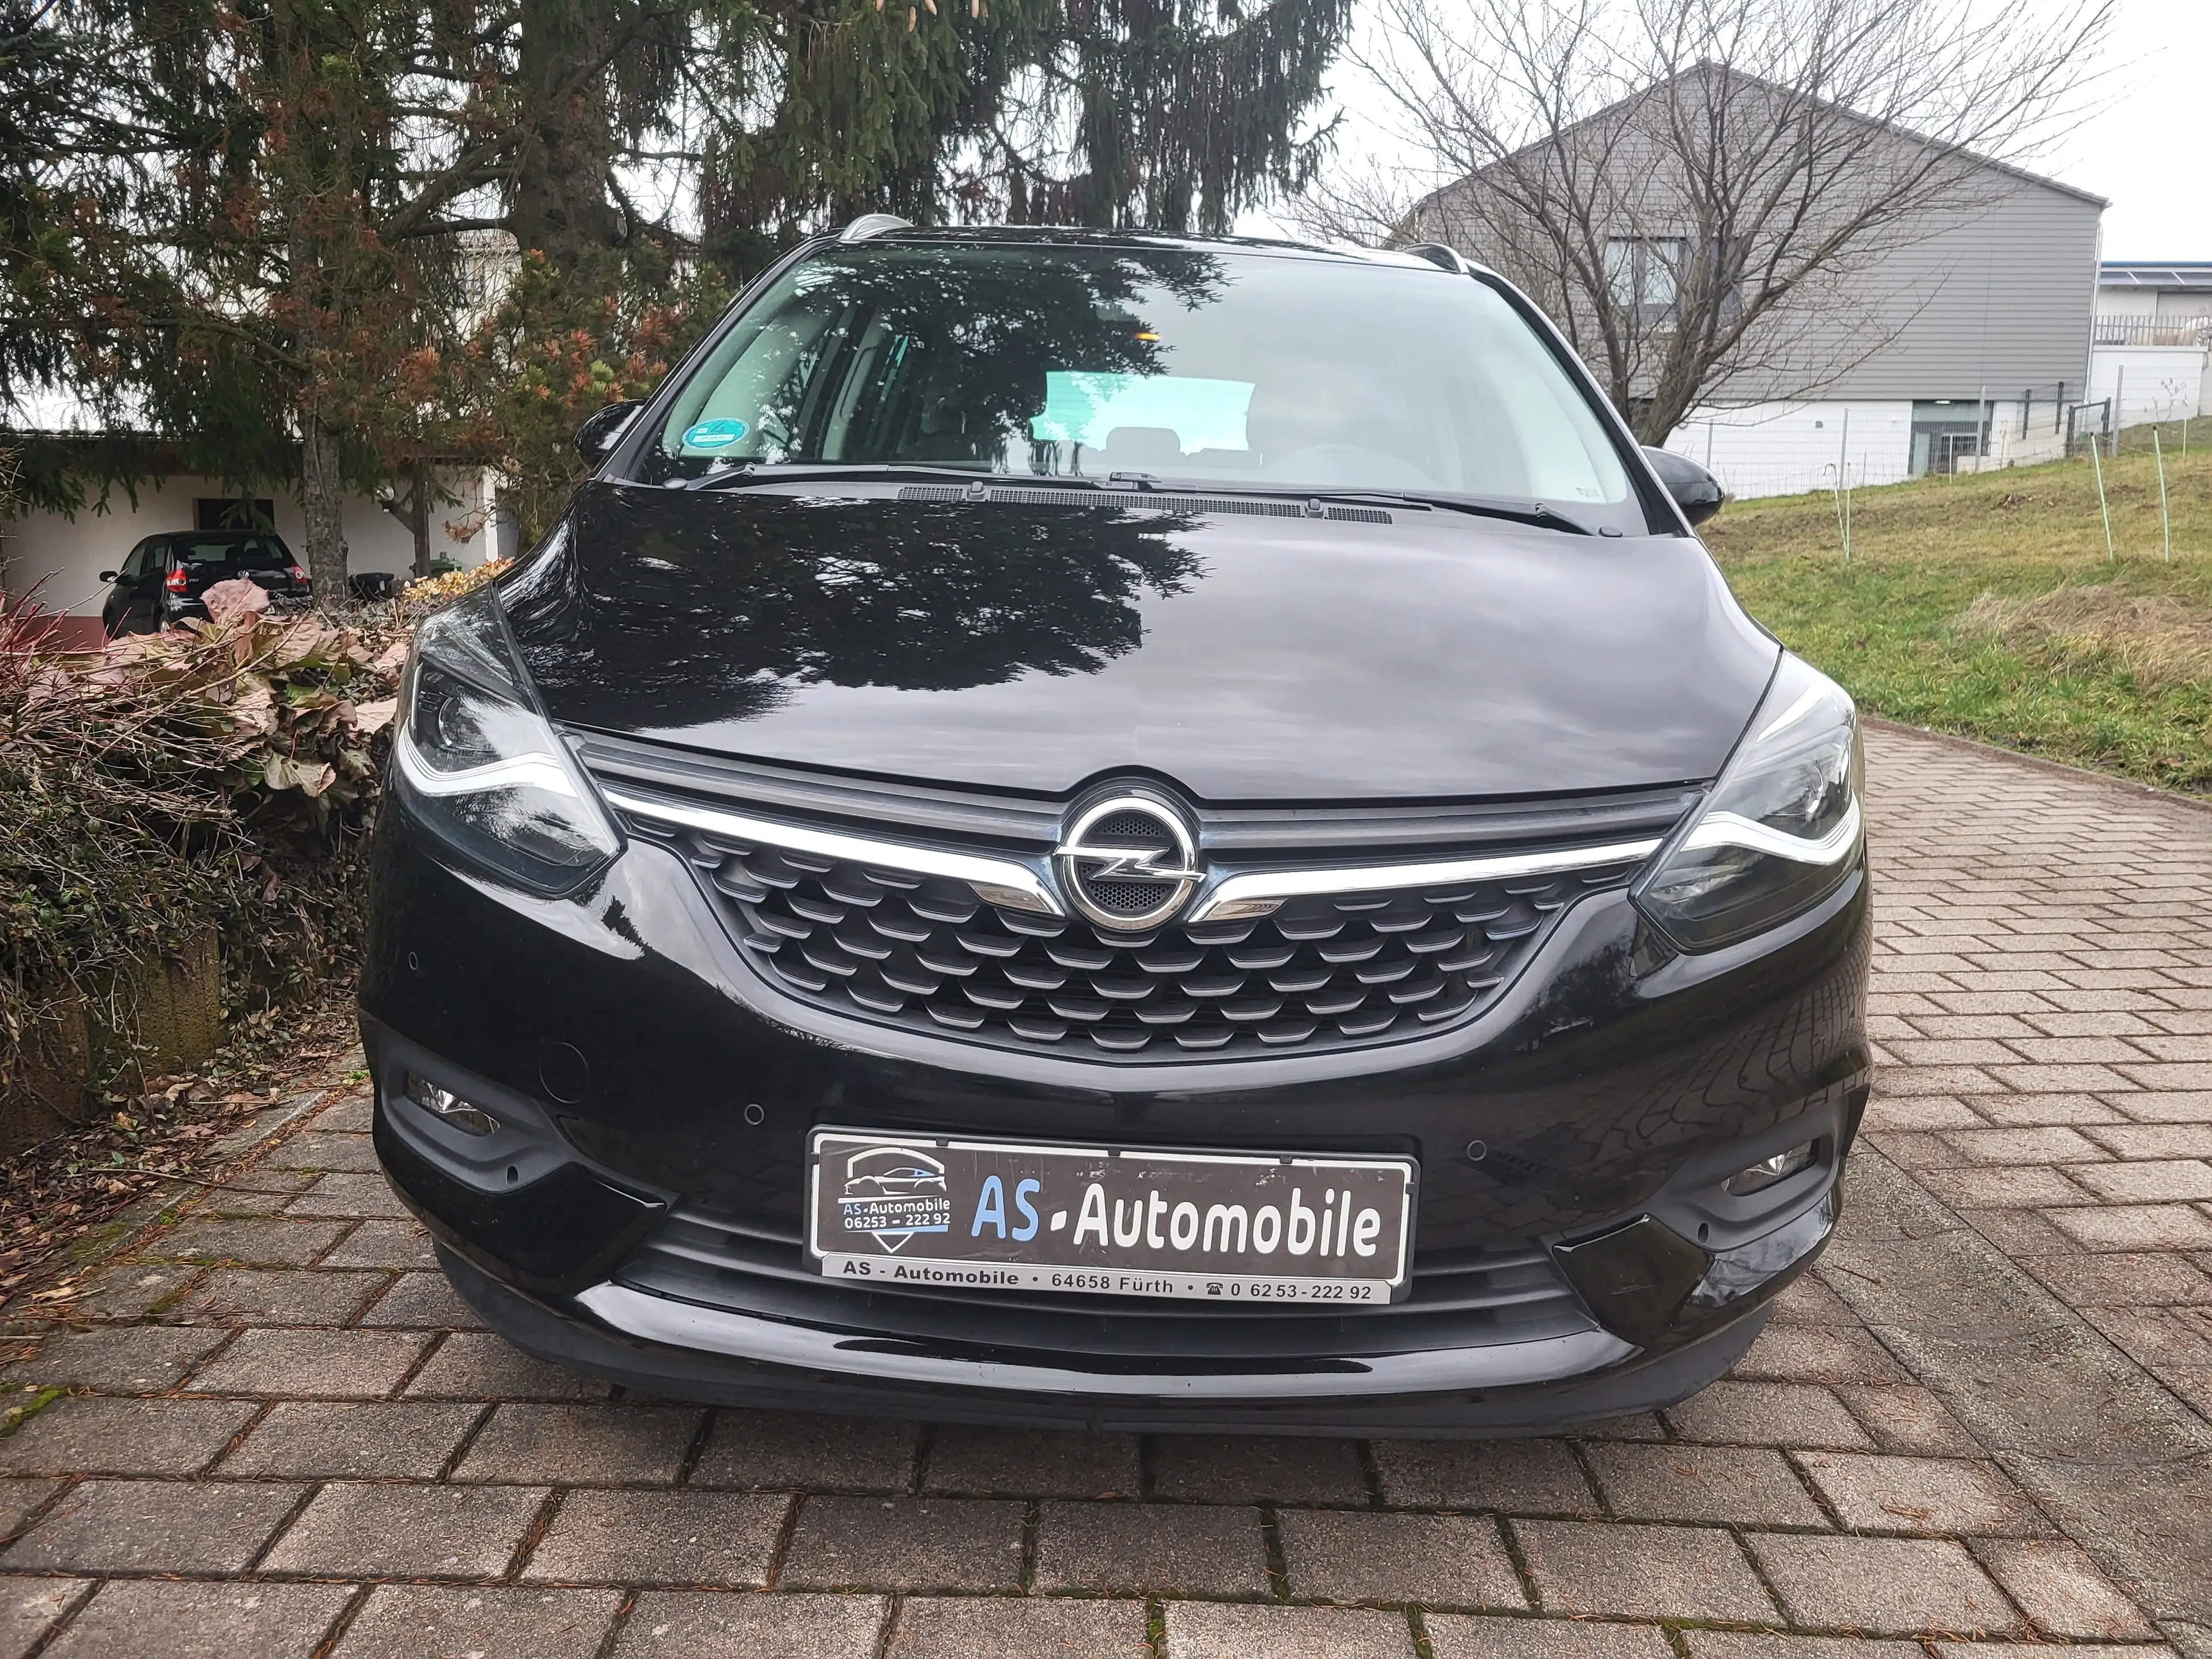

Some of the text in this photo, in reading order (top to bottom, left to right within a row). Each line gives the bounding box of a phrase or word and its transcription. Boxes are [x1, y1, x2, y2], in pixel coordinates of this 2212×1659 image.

[844, 1215, 888, 1229] 06253
[843, 1261, 871, 1275] AS
[893, 1265, 1020, 1285] Automobile
[1052, 1273, 1110, 1289] 64658
[1119, 1277, 1173, 1293] Fürth
